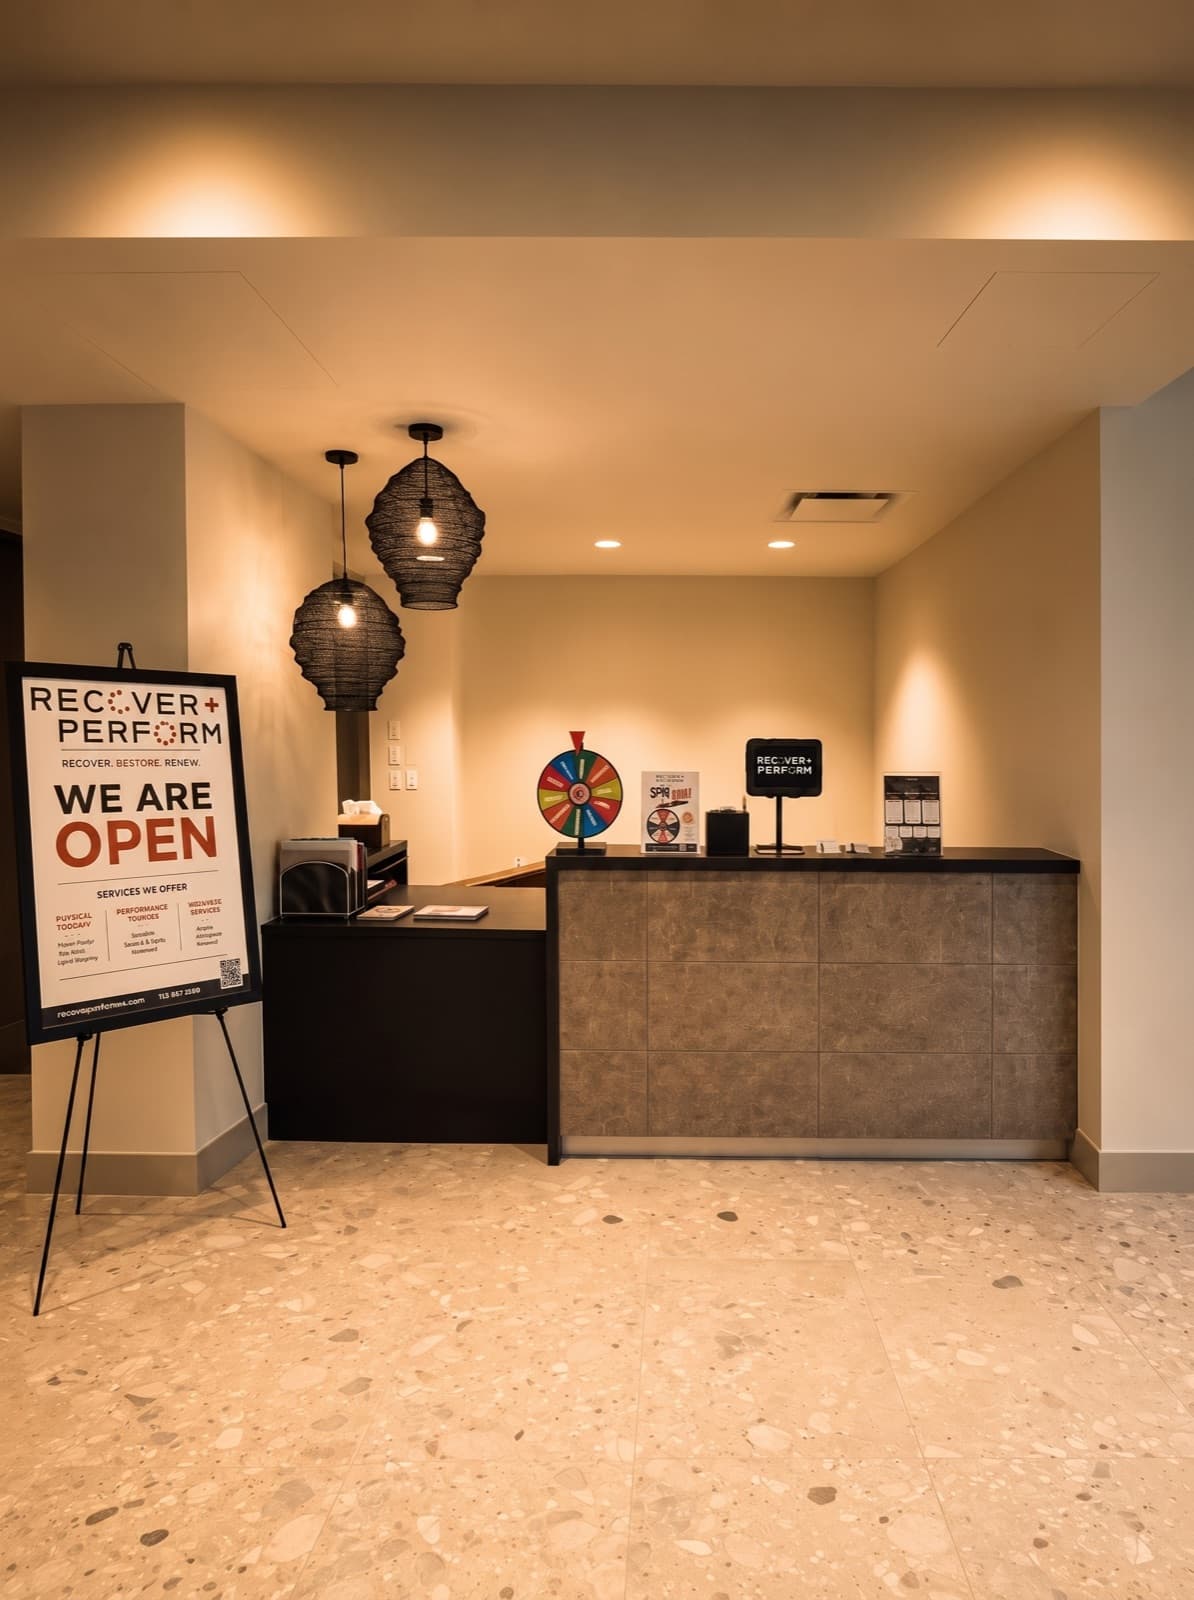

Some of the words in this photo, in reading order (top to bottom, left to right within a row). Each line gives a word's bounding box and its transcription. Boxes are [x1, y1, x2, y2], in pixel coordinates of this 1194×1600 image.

[58, 718, 222, 746] PERFORM
[62, 759, 114, 768] RECOVER.
[164, 758, 201, 768] RENEW.
[757, 766, 813, 775] PERFORM
[54, 784, 123, 815] WE
[136, 781, 213, 812] ARE
[55, 815, 217, 868] OPEN
[96, 887, 141, 899] SERVICES
[142, 885, 158, 895] WE
[159, 882, 188, 893] OFFER
[116, 903, 169, 916] PERFORMANCE
[190, 906, 221, 917] SERVICES
